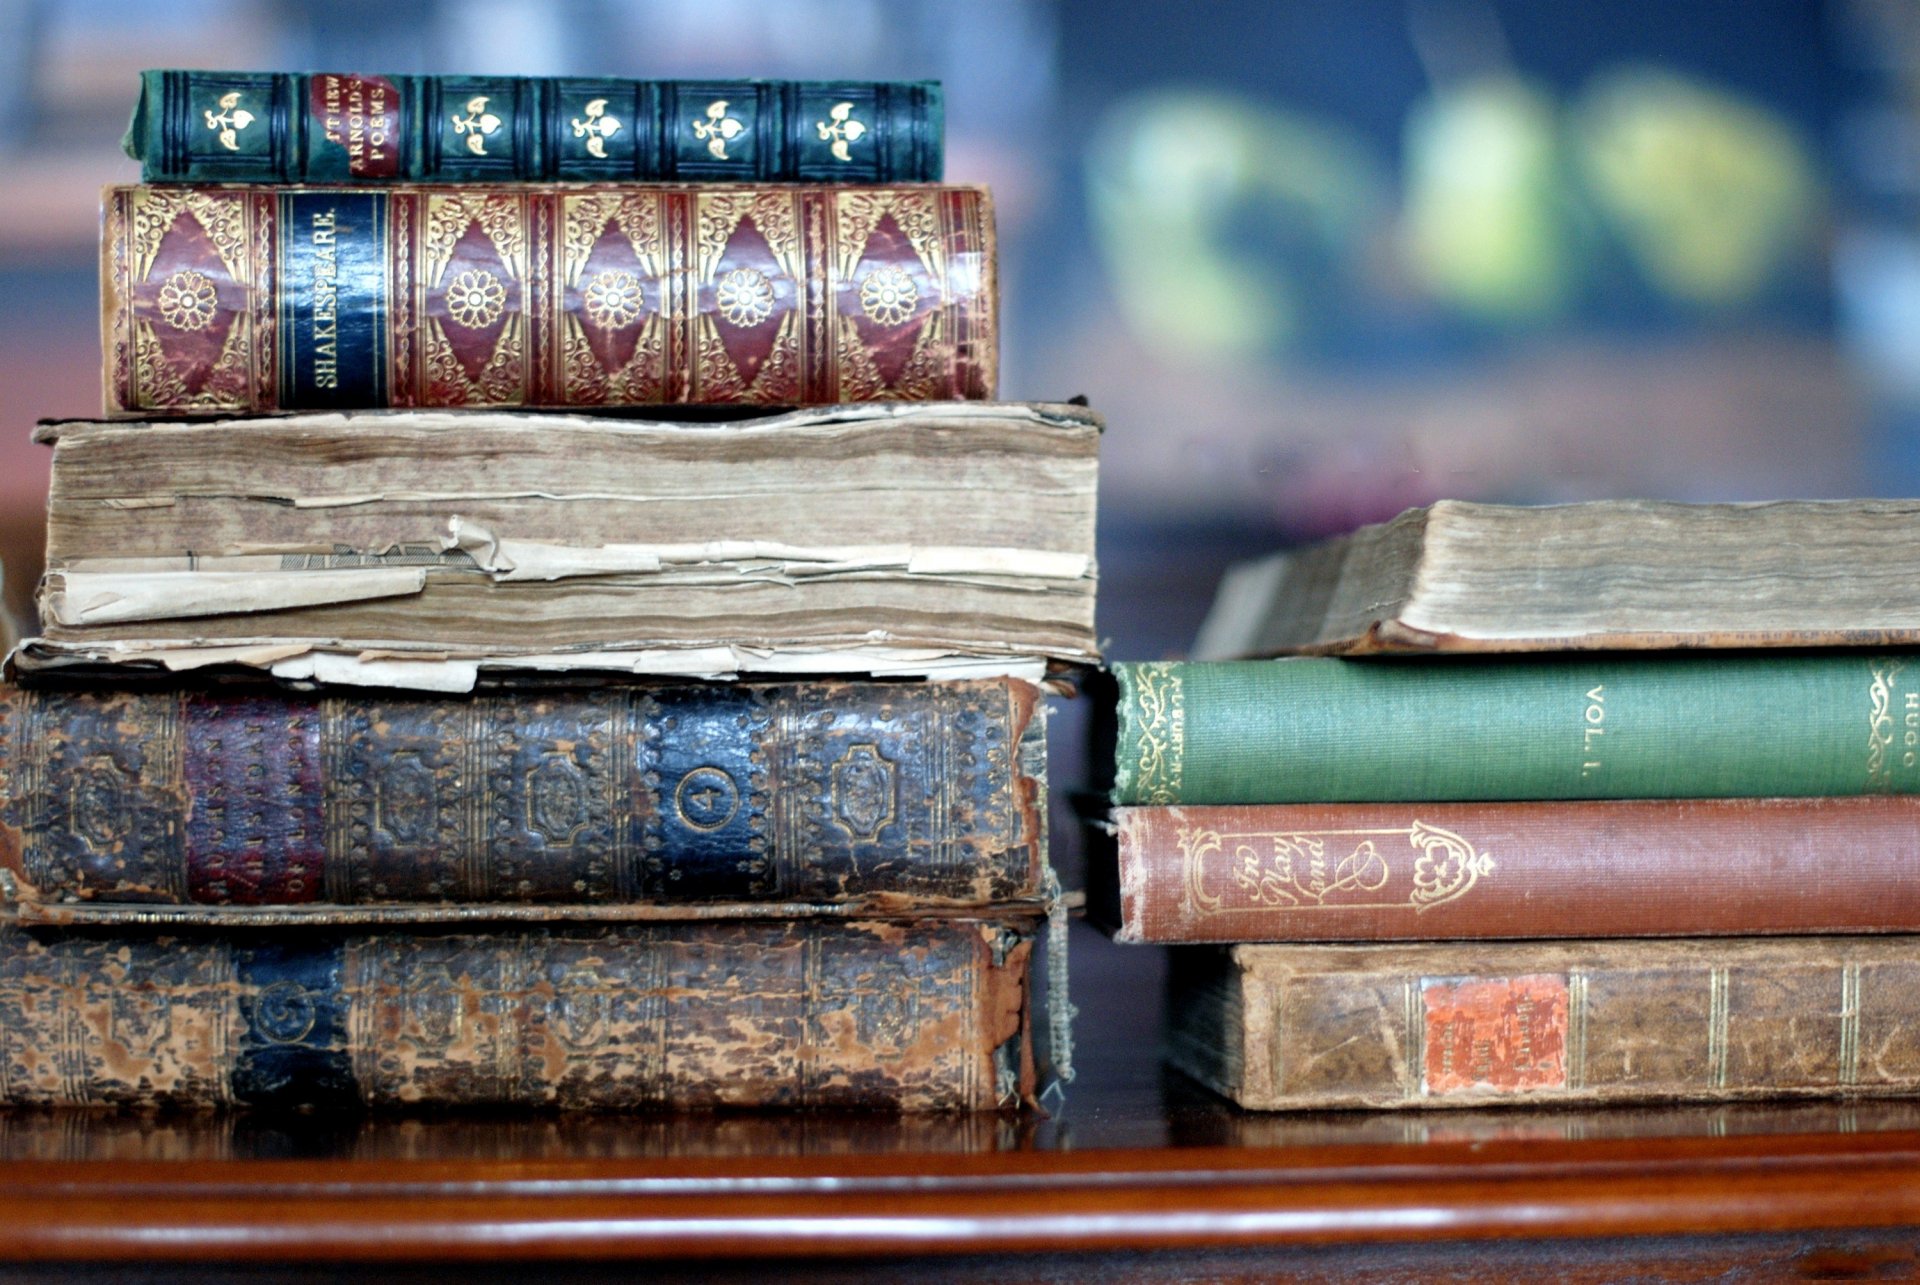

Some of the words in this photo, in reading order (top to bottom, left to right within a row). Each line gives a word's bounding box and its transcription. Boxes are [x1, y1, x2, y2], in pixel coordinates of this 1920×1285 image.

[371, 82, 385, 161] POEMS.
[312, 207, 338, 389] SHAKESPEARE.
[1584, 684, 1605, 752] VOL.
[1903, 692, 1920, 768] HUGO
[691, 787, 722, 812] 4
[287, 862, 305, 892] OF
[1232, 844, 1262, 901] In
[1260, 836, 1305, 905] Play
